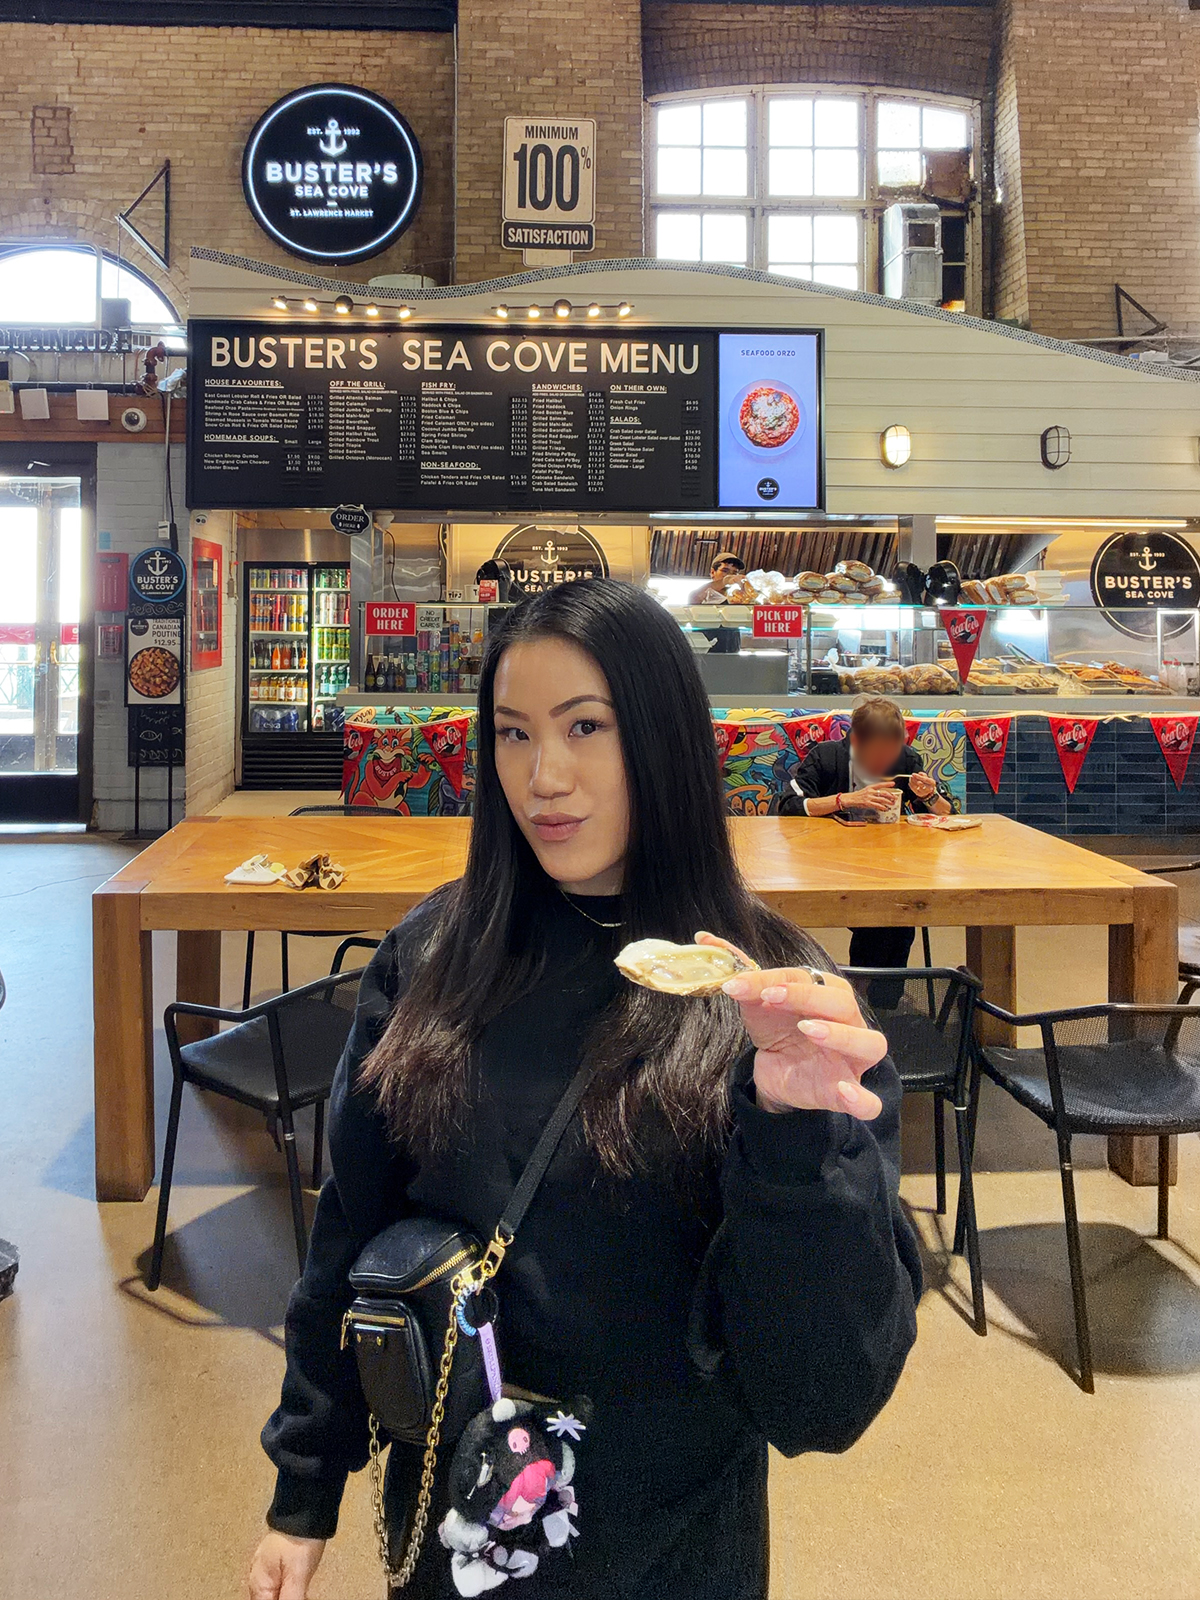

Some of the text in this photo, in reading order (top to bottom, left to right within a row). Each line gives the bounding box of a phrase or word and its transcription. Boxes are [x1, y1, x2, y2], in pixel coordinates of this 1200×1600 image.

[525, 126, 578, 140] MINIMUM
[266, 162, 398, 183] BUSTER'S
[514, 144, 591, 211] 100%
[295, 185, 368, 197] SEA COVE
[290, 209, 373, 217] ST. LAWRENCE MARKET
[508, 228, 588, 244] SATISFACTION
[211, 336, 699, 375] BUSTER'S SEA COVE MENU
[336, 514, 364, 522] ORDER
[1104, 576, 1192, 589] BUSTER'S
[372, 608, 409, 618] ORDER
[756, 610, 798, 621] PICK-UP
[376, 620, 404, 630] HERE
[764, 622, 791, 632] HERE
